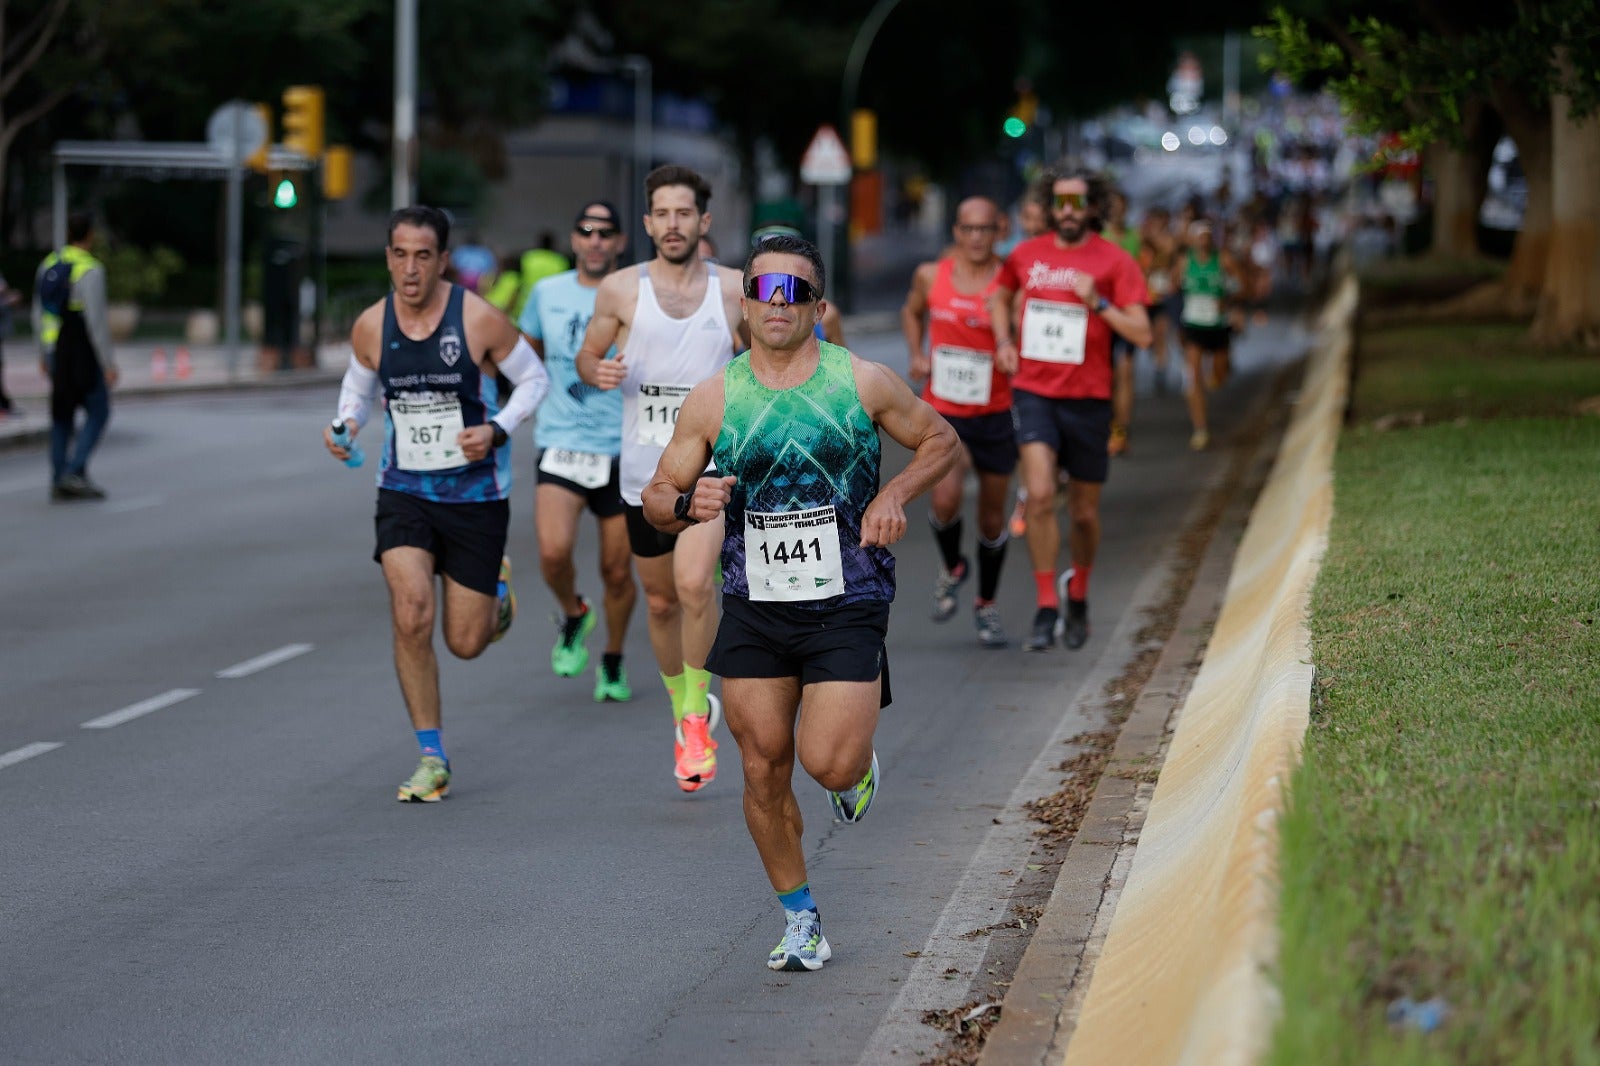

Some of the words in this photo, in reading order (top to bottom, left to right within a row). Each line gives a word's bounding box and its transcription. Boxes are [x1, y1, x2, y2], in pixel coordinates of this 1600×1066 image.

[409, 425, 444, 444] 267
[747, 513, 766, 530] 43
[765, 514, 800, 522] CARRERA
[801, 508, 834, 519] URBANA
[760, 537, 822, 565] 1441
